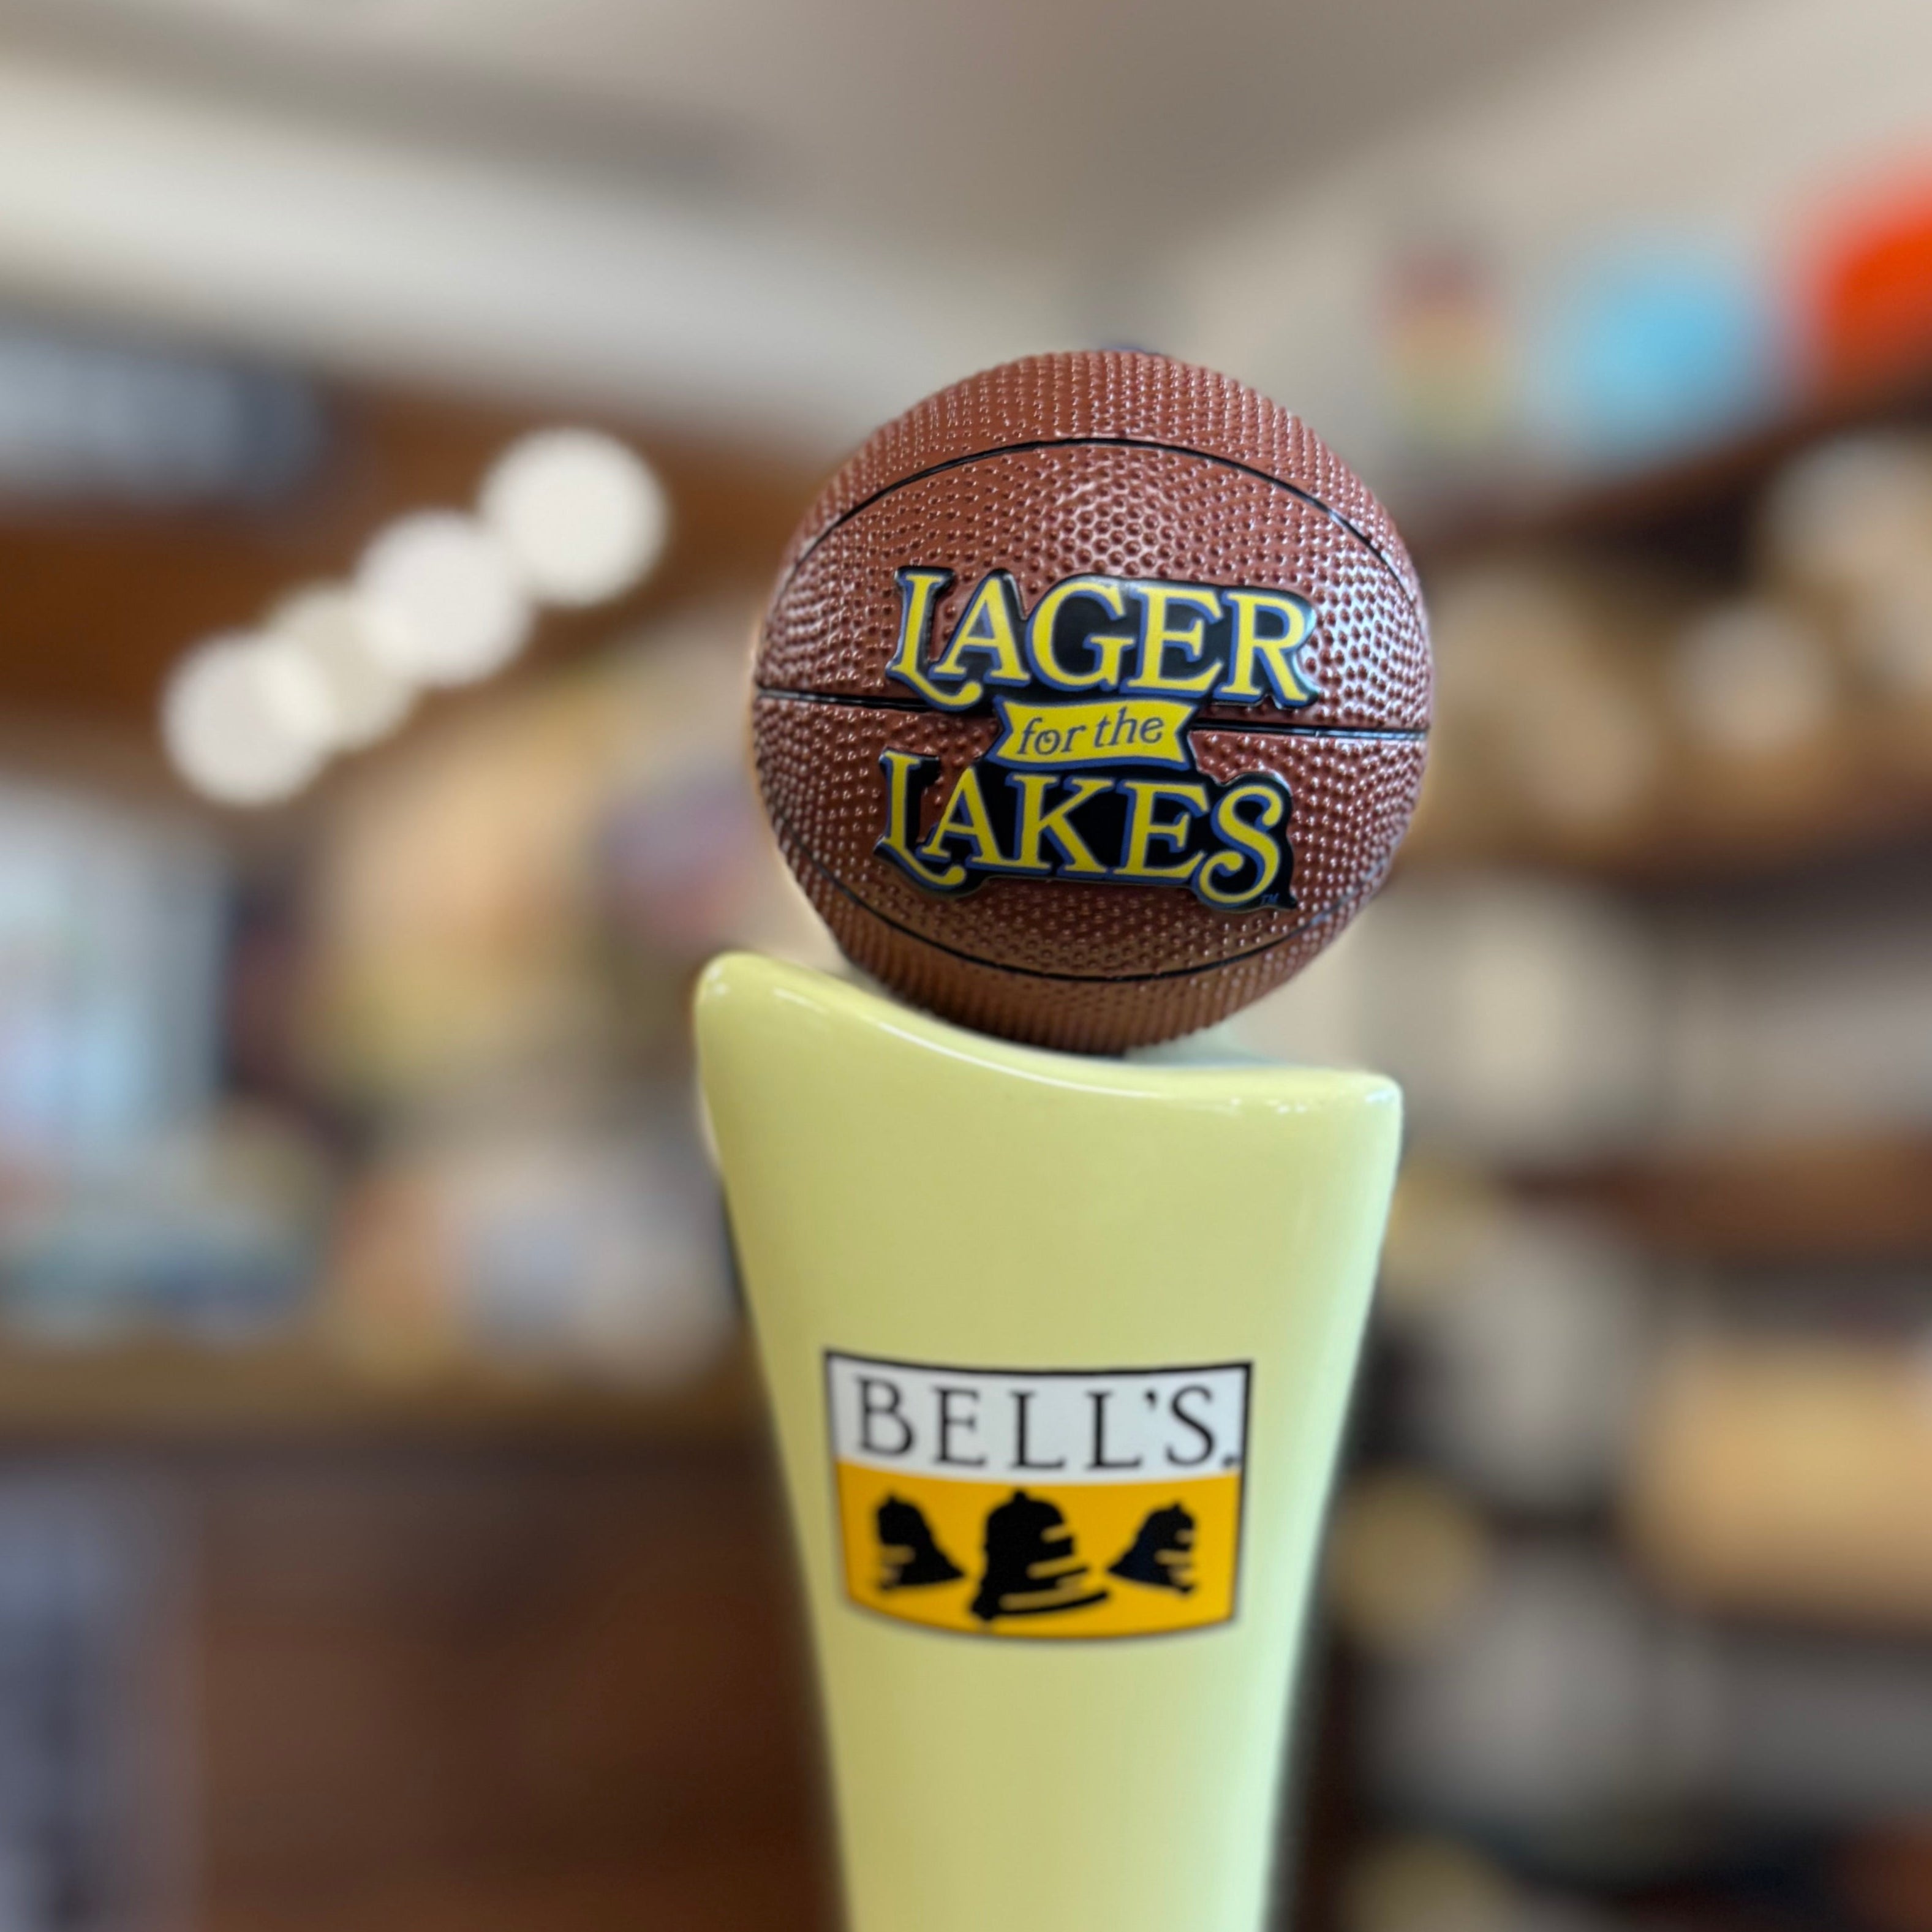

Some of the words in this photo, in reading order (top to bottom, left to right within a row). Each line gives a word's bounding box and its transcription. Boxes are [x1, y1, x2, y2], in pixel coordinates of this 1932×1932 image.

[886, 572, 1310, 708] LAGER
[1016, 717, 1087, 755] for
[1093, 707, 1164, 746] the
[877, 752, 1284, 905] LAKES
[855, 1375, 1218, 1470] BELL'S
